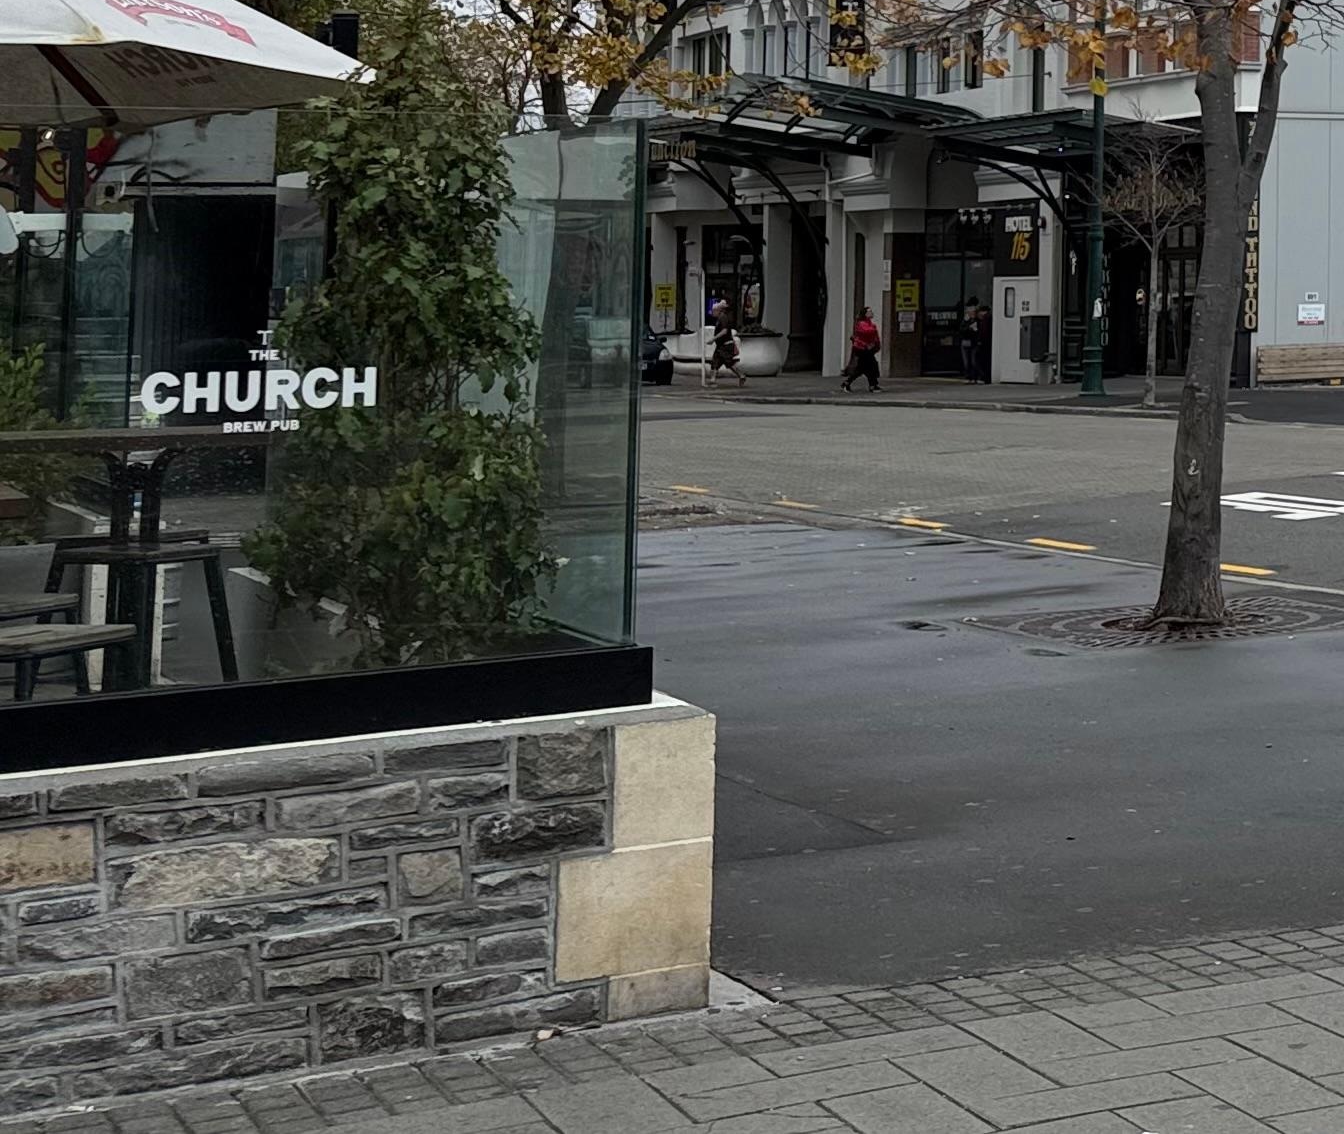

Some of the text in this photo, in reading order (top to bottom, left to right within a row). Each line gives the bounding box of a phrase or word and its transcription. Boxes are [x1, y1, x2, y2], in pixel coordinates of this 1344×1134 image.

[1005, 216, 1033, 233] HOTEL
[1011, 232, 1033, 260] 115
[1244, 236, 1258, 329] TATTOO
[249, 349, 280, 361] THE
[141, 367, 378, 415] CHURCH
[223, 419, 300, 434] BREW PUB
